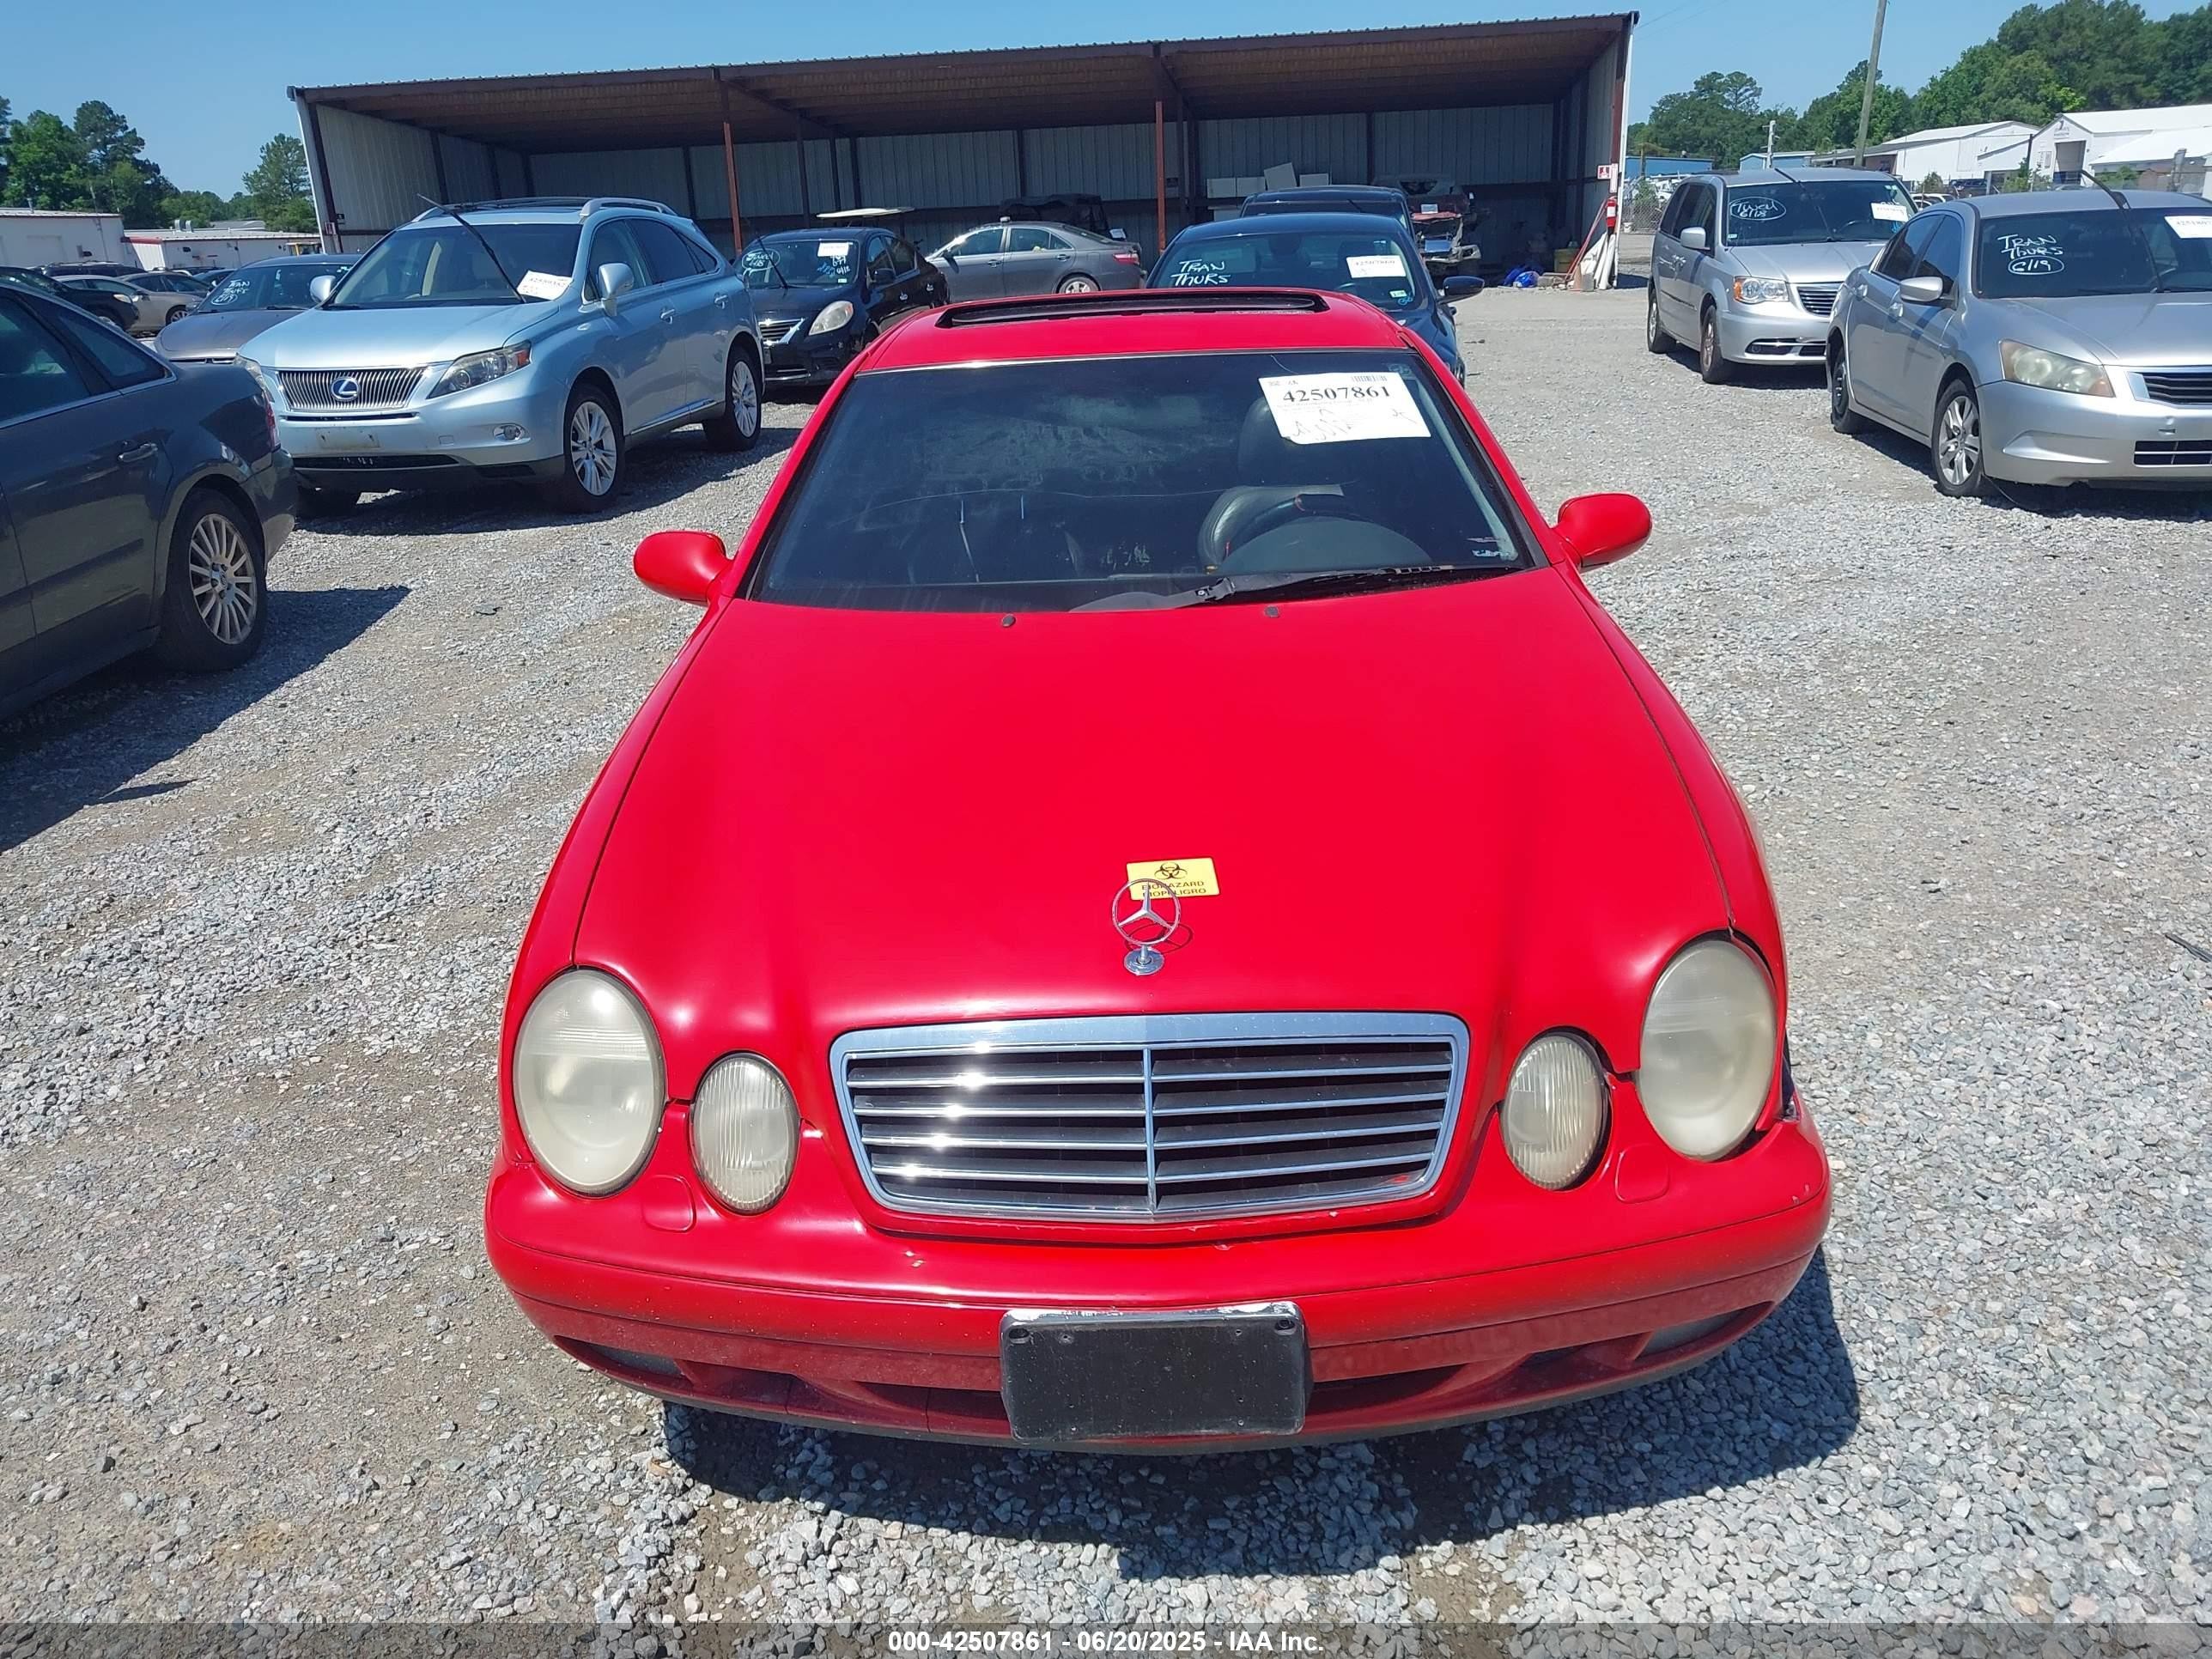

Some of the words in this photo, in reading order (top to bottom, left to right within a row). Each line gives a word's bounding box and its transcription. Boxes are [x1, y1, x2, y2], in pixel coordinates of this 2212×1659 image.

[1996, 234, 2057, 249] TRAN
[1179, 258, 1225, 273] TRAN
[1283, 386, 1390, 403] 42507861
